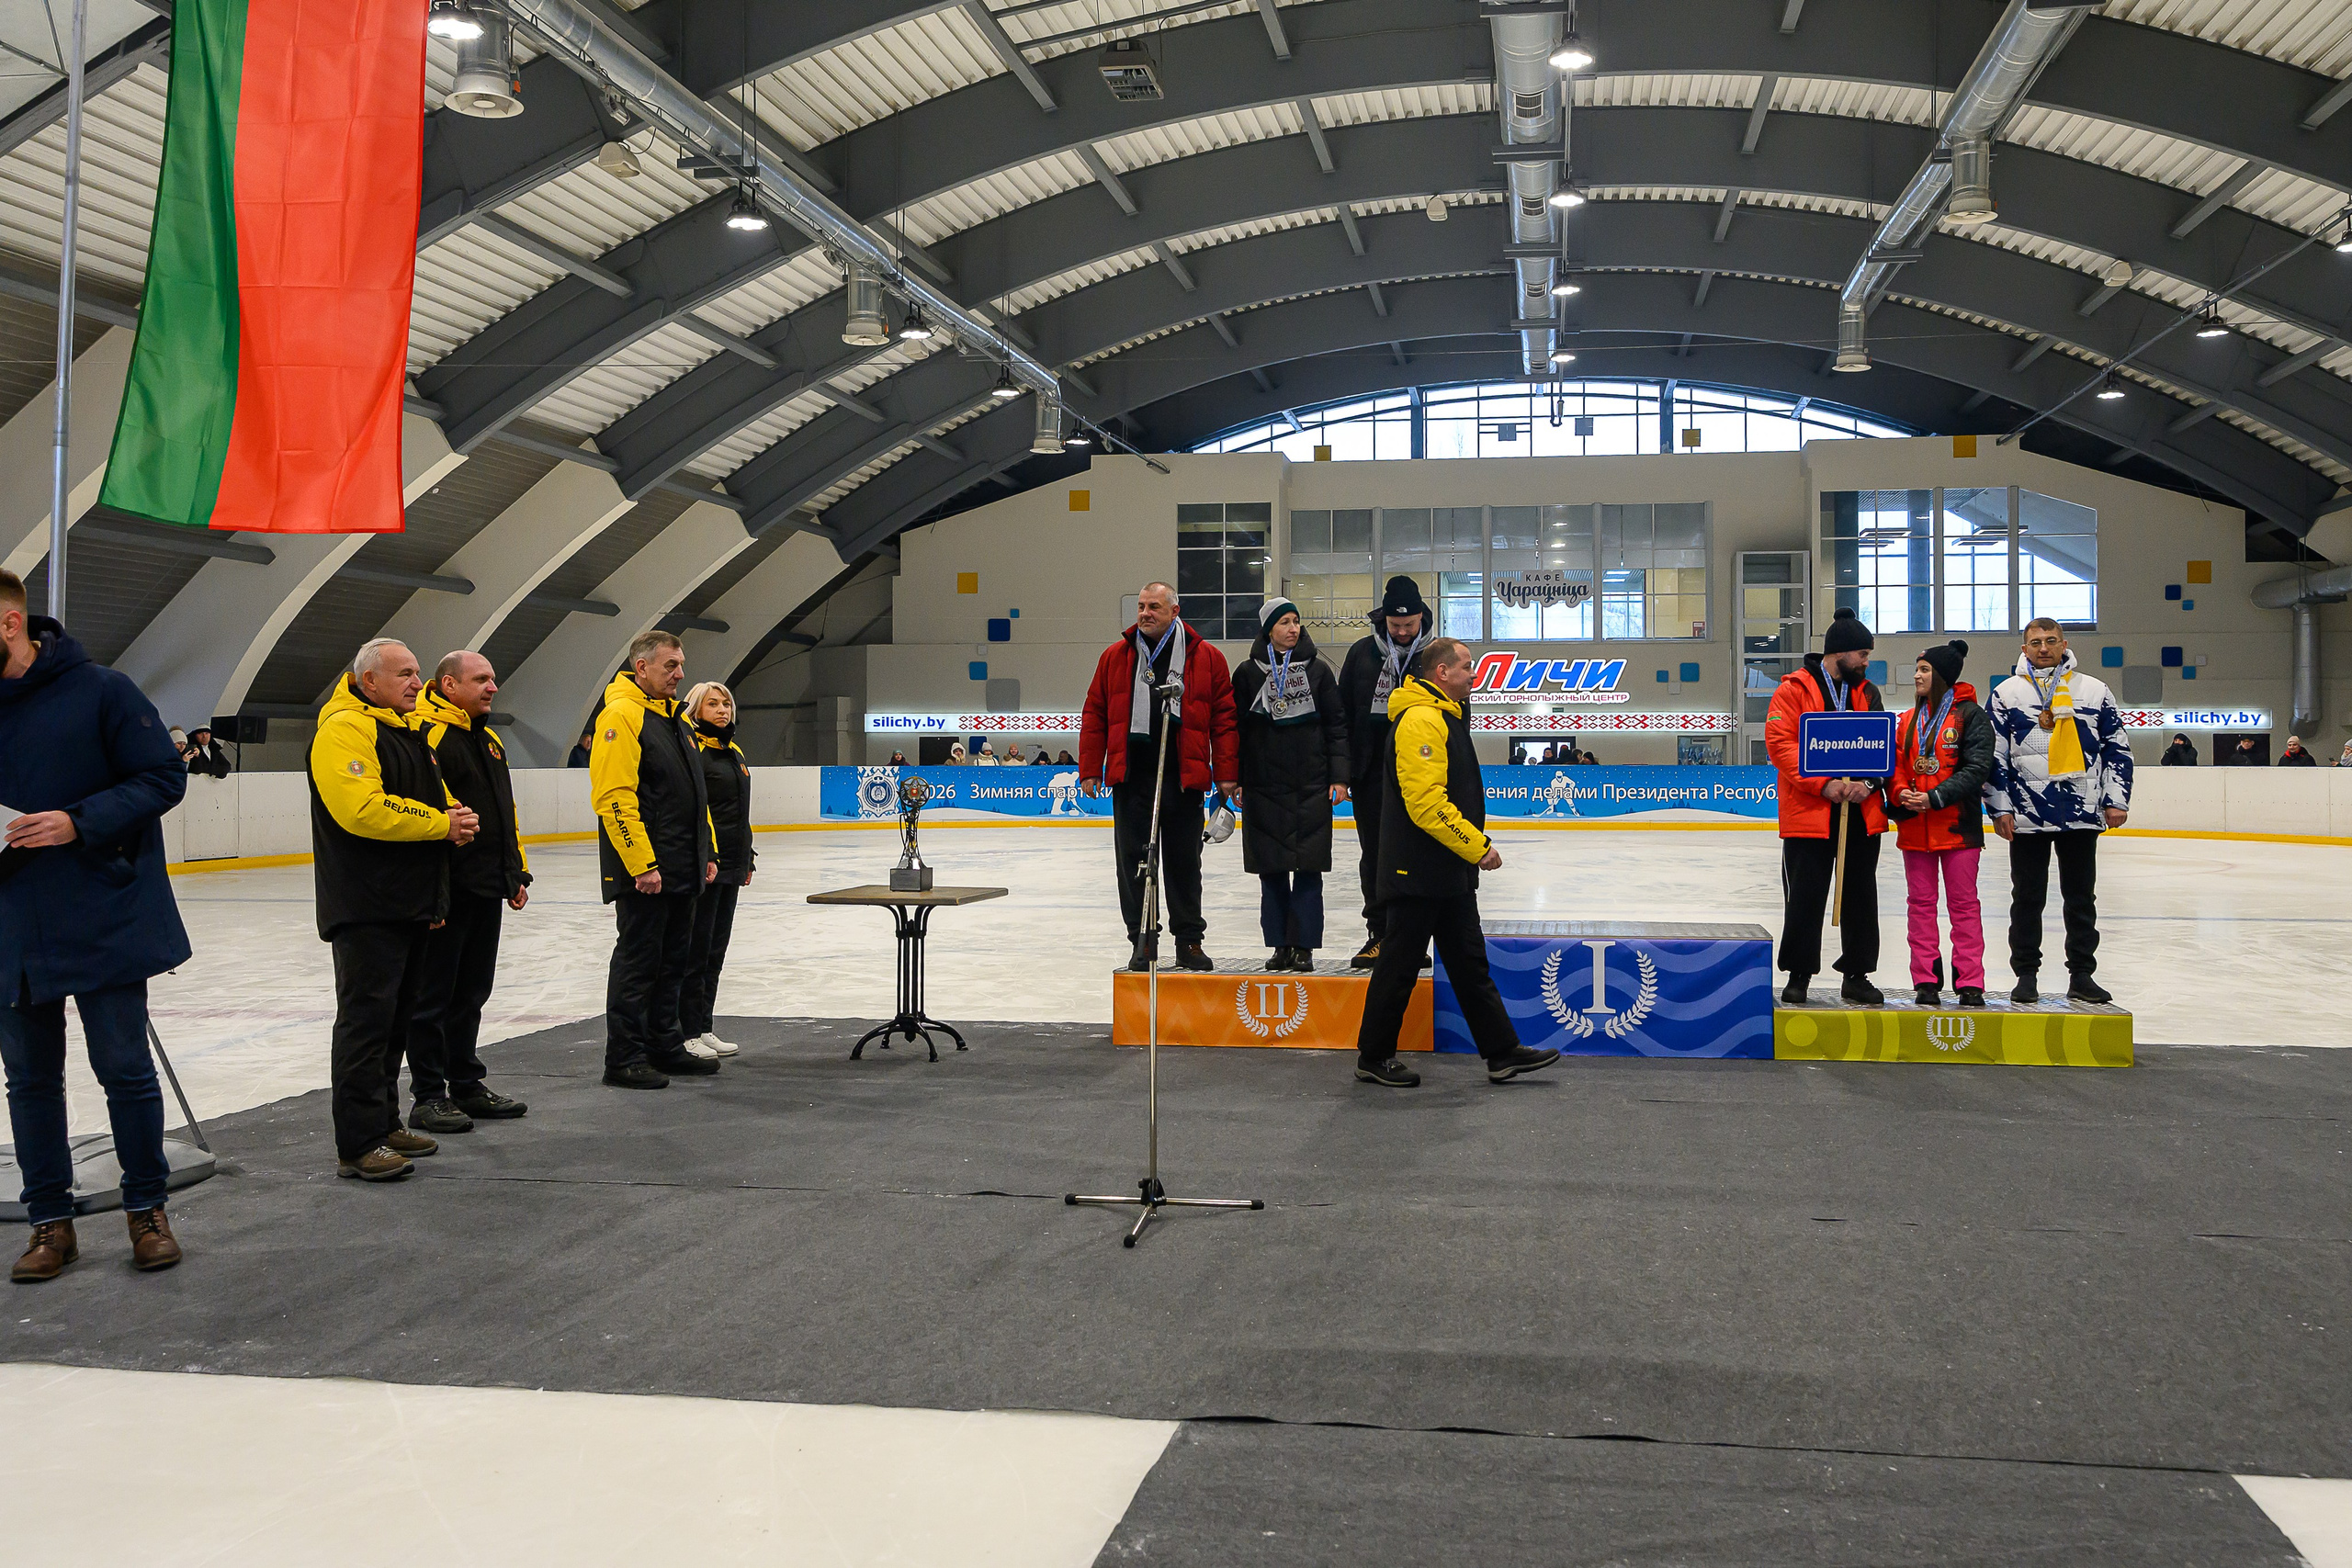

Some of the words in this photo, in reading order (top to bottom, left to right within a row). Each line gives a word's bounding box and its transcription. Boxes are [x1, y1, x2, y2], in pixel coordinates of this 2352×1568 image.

[1525, 573, 1560, 582] КАФЕ
[1470, 694, 1501, 702] СКИЙ
[1503, 694, 1590, 702] ГОРНОЛЫЖНЫЙ
[1592, 694, 1628, 703] ЦЕНТР
[873, 716, 945, 729] silichy.by
[2174, 711, 2262, 726] silichy.by
[1809, 736, 1885, 753] Агрохолдинг
[928, 784, 956, 800] 026
[969, 784, 1034, 800] Зимняя
[1483, 786, 1528, 799] ения
[1532, 786, 1598, 802] делами
[1602, 784, 1709, 802] Президента
[1713, 783, 1779, 805] Респуб
[611, 801, 634, 849] BELARUS
[1436, 810, 1471, 845] BELARUS
[1254, 983, 1290, 1019] II
[1934, 1016, 1969, 1038] III
